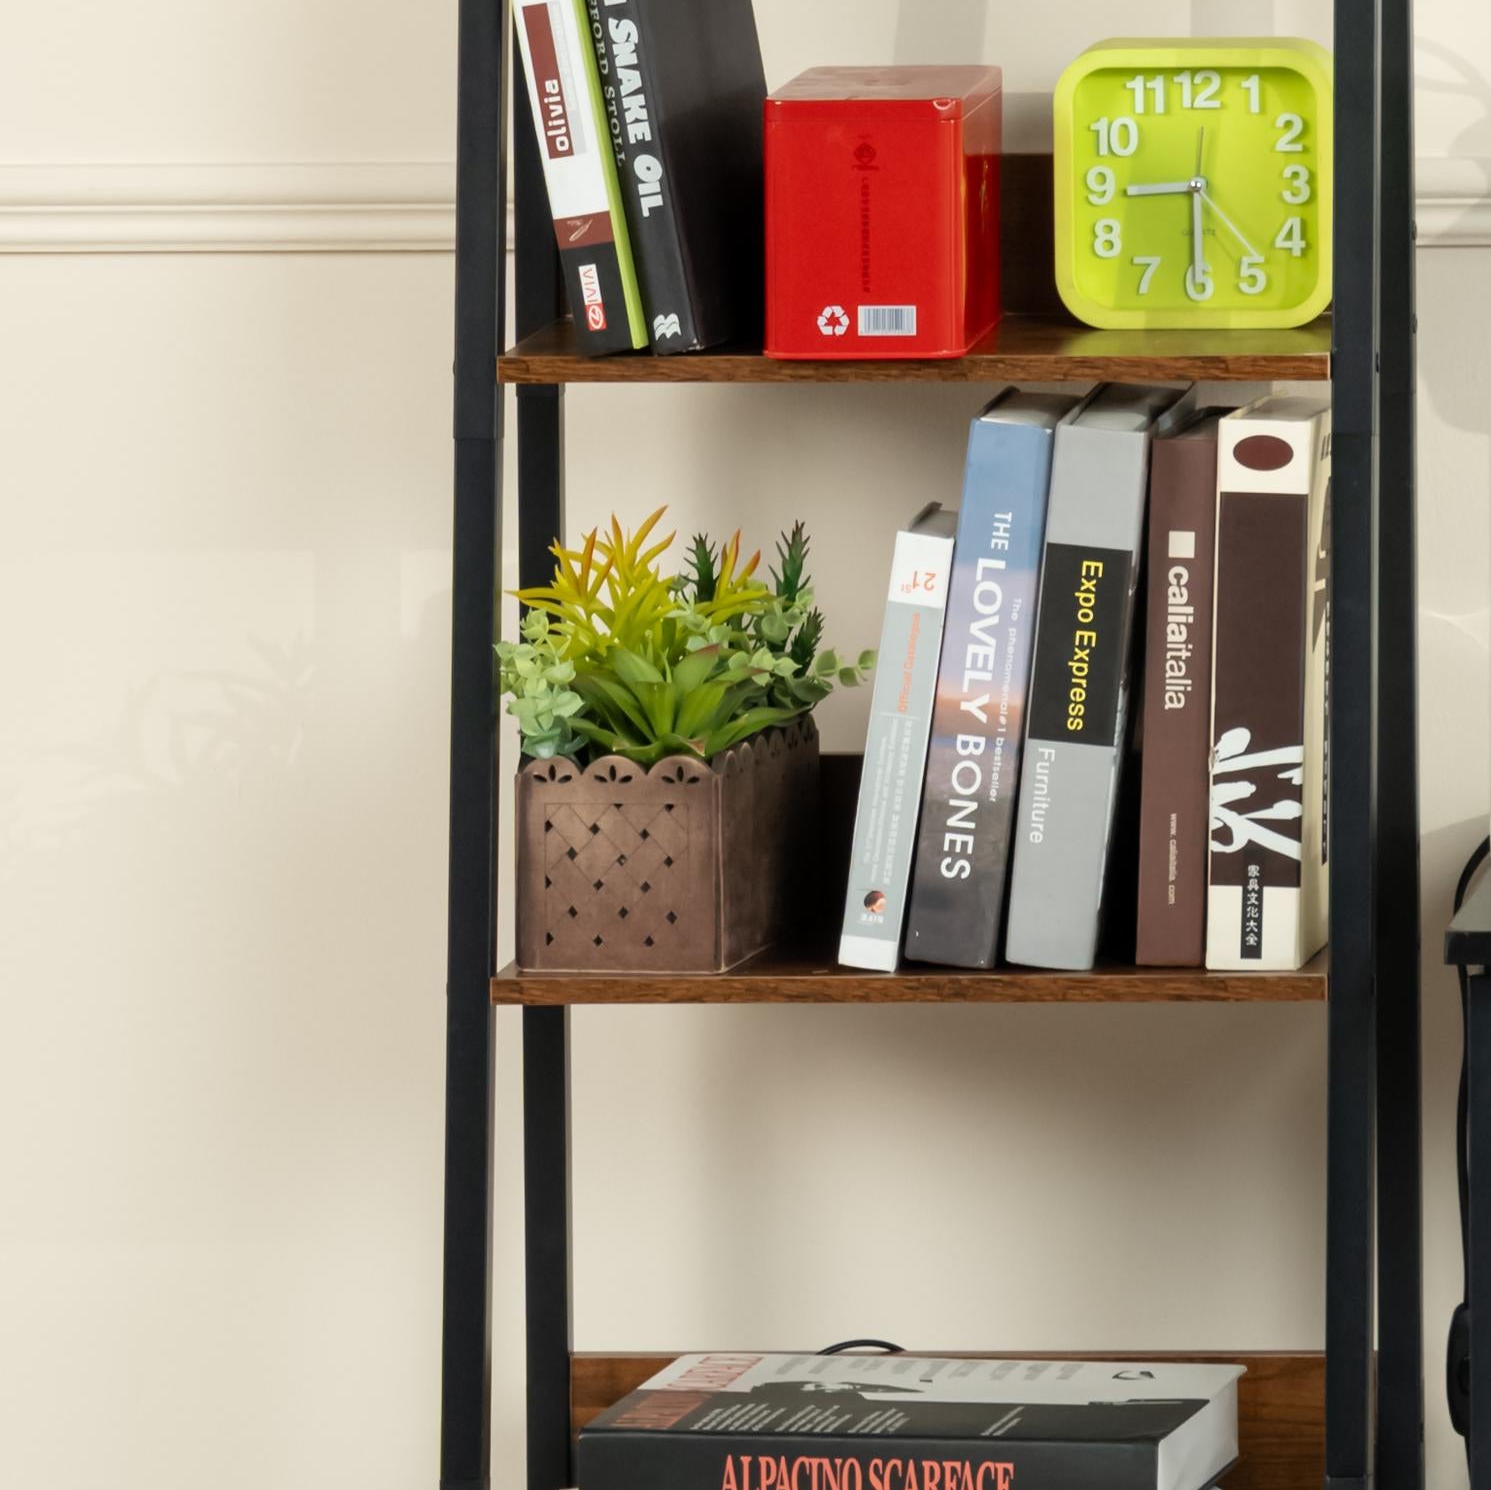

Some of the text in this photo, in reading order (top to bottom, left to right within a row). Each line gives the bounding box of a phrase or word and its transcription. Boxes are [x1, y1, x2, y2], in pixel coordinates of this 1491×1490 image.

[1125, 75, 1166, 114] 11
[1173, 70, 1222, 109] 12
[1241, 75, 1261, 114] 1
[545, 78, 571, 153] olivia
[603, 85, 627, 168] STOLL
[607, 17, 653, 146] SNAKE
[633, 153, 666, 218] OIL
[1274, 113, 1304, 152] 2
[1089, 116, 1139, 157] 10
[1086, 165, 1116, 206] 9
[1281, 164, 1311, 205] 3
[1093, 218, 1122, 258] 8
[1274, 217, 1306, 257] 4
[1132, 256, 1161, 295] 7
[1185, 262, 1215, 302] 6
[1238, 256, 1267, 295] 5
[1010, 597, 1022, 622] The
[1066, 560, 1104, 732] Expo Express
[1163, 565, 1194, 711] caliaitalia
[940, 510, 1013, 881] THE LOVELY BONES
[989, 737, 1005, 803] bestseller
[1028, 747, 1056, 845] Furniture
[1244, 863, 1261, 947] 家具文化大全
